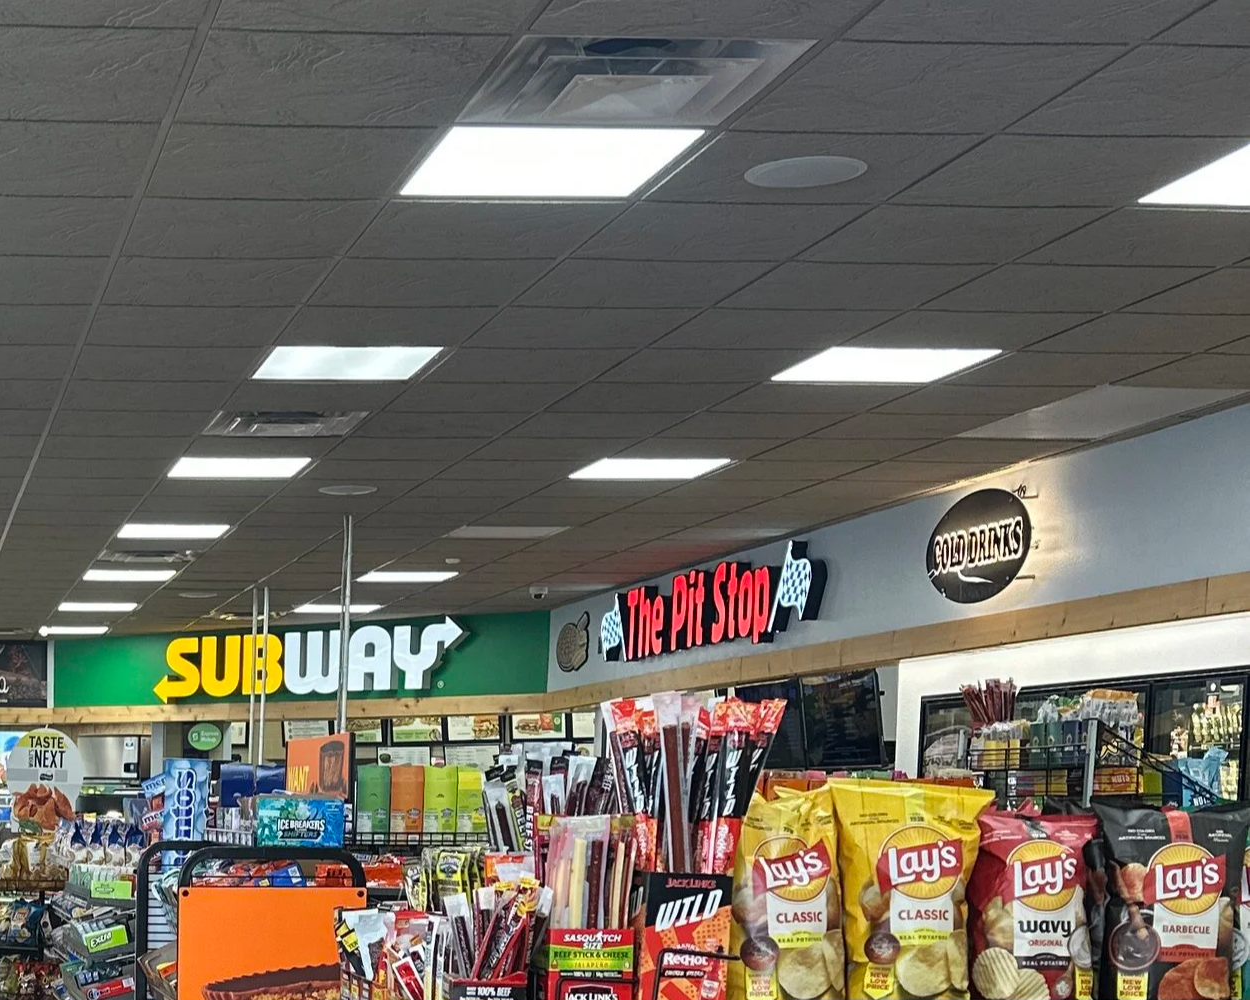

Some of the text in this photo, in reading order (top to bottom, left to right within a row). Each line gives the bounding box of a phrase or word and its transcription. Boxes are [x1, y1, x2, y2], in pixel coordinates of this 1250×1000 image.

[933, 515, 1024, 573] COLD DRINKS
[627, 561, 770, 661] The Pit Stop
[153, 615, 464, 705] SUBWAY
[29, 736, 64, 749] TASTE
[35, 751, 66, 768] NEXT
[725, 749, 744, 814] WILD
[759, 850, 824, 890] Lay's
[888, 840, 957, 886] Lay's
[1014, 853, 1077, 898] Lay's
[1155, 858, 1220, 901] Lay's
[655, 889, 723, 932] WILD
[776, 911, 823, 924] CLASSIC
[898, 909, 949, 921] CLASSIC
[563, 931, 622, 942] SASQUATCH
[1018, 919, 1073, 935] wavy
[1162, 924, 1211, 934] BARBECUE
[582, 942, 603, 950] SIZE
[477, 987, 512, 996] 100% BEEF
